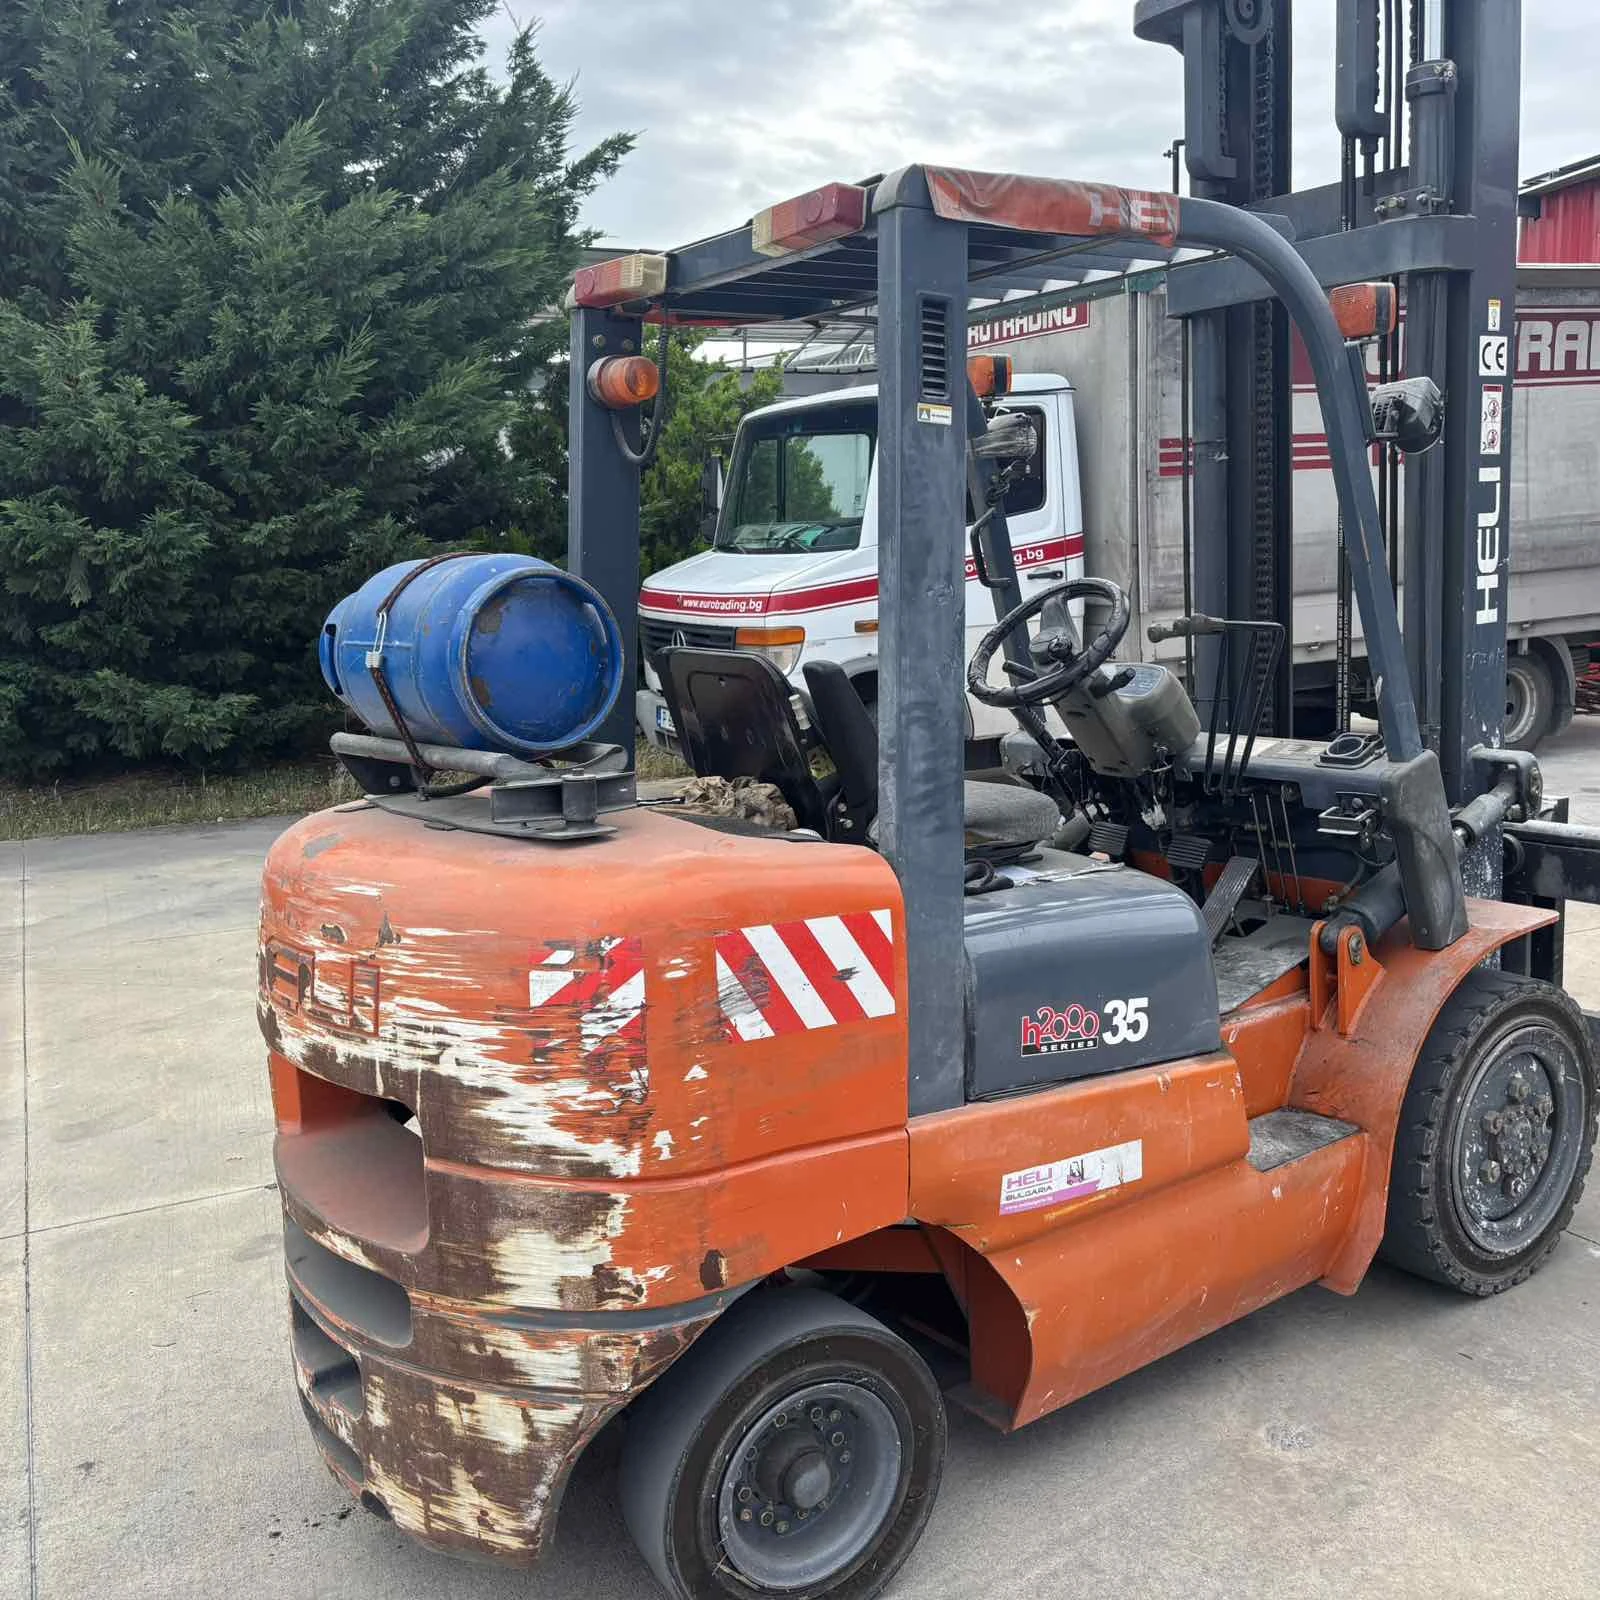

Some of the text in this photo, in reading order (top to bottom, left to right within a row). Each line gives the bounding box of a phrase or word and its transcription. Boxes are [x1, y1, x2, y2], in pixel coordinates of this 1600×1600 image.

[1088, 191, 1177, 232] HE
[1482, 341, 1505, 371] CE
[1476, 466, 1501, 625] HELI
[683, 598, 763, 612] www.eurotrading.bg
[1021, 996, 1149, 1051] h2000 35
[1040, 1039, 1095, 1053] SERIES
[1006, 1167, 1053, 1190] HELI
[1006, 1185, 1053, 1202] BULGARIA
